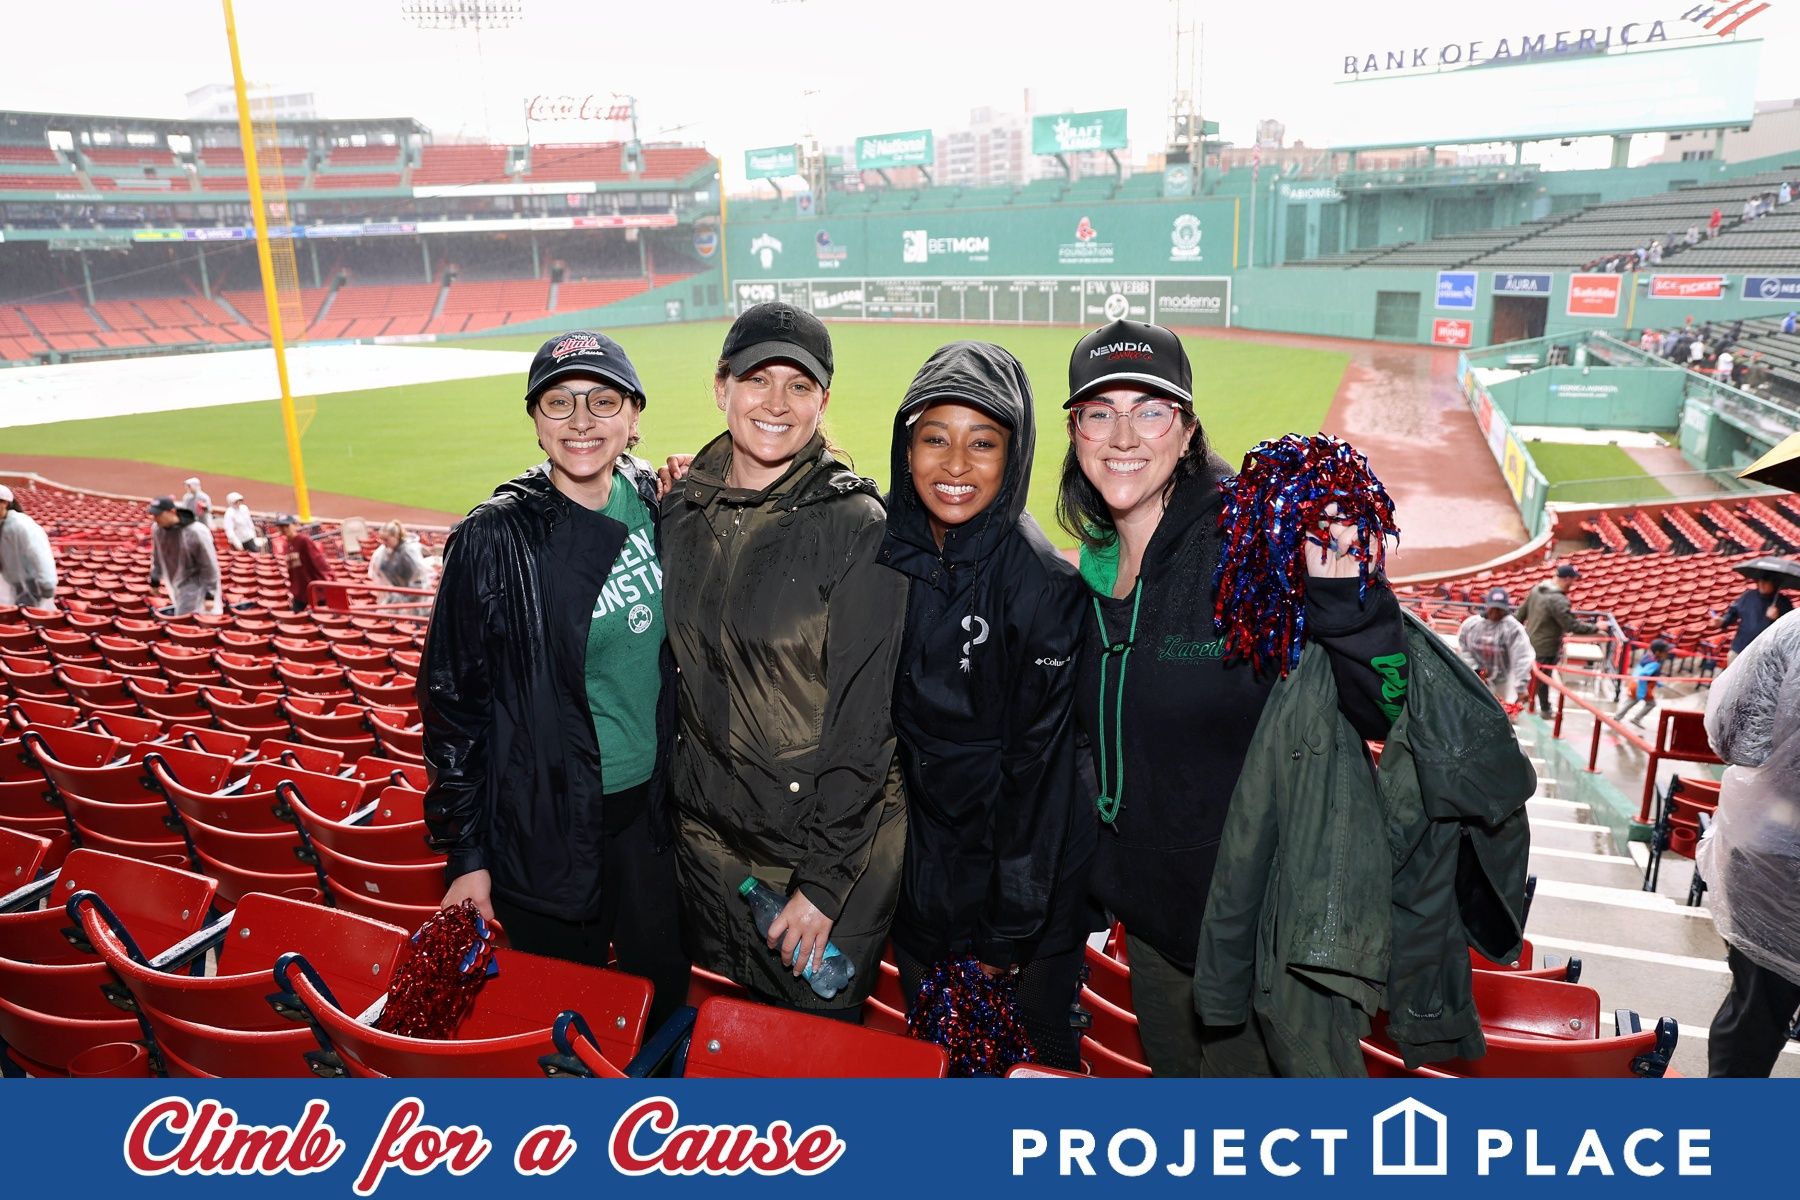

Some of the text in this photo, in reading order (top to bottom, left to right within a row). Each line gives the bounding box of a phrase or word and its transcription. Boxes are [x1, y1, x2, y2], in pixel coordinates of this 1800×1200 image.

[1344, 20, 1668, 75] BANK OF AMERICA
[878, 135, 927, 155] National
[928, 237, 990, 254] BETMGM
[750, 284, 775, 300] CVS
[1110, 281, 1149, 295] WEBB
[1158, 294, 1221, 308] moderna
[552, 337, 601, 358] Climb
[611, 529, 655, 574] EN
